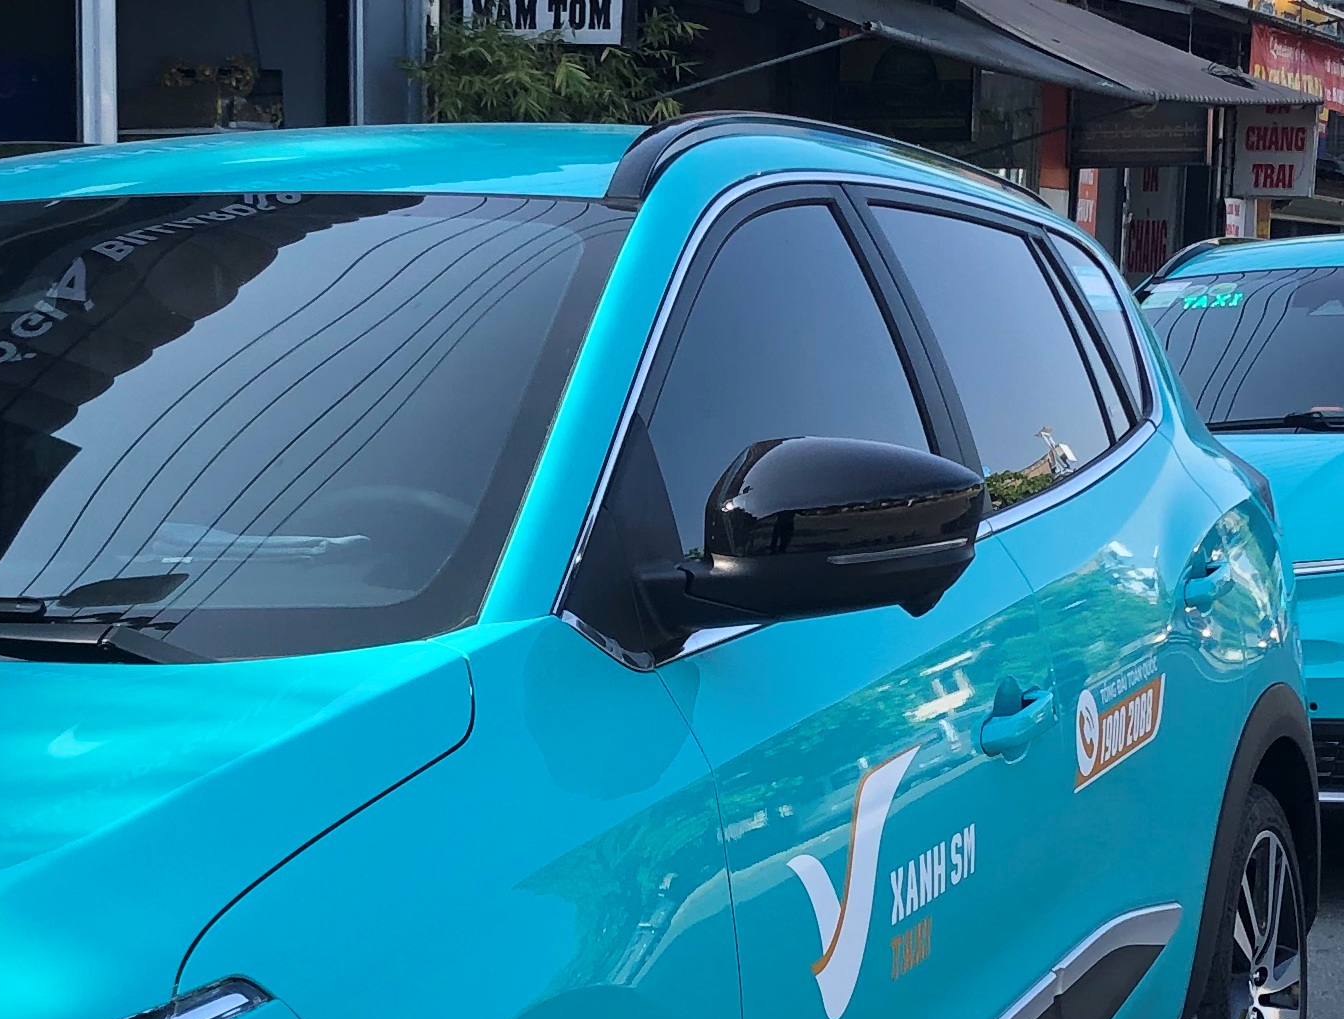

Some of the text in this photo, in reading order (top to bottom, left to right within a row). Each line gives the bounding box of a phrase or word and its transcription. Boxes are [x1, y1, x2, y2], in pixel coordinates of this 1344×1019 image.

[1252, 163, 1294, 189] TRAI
[1183, 292, 1243, 310] TAXI
[1100, 688, 1154, 765] 1900 2088
[890, 823, 976, 926] XANH SM
